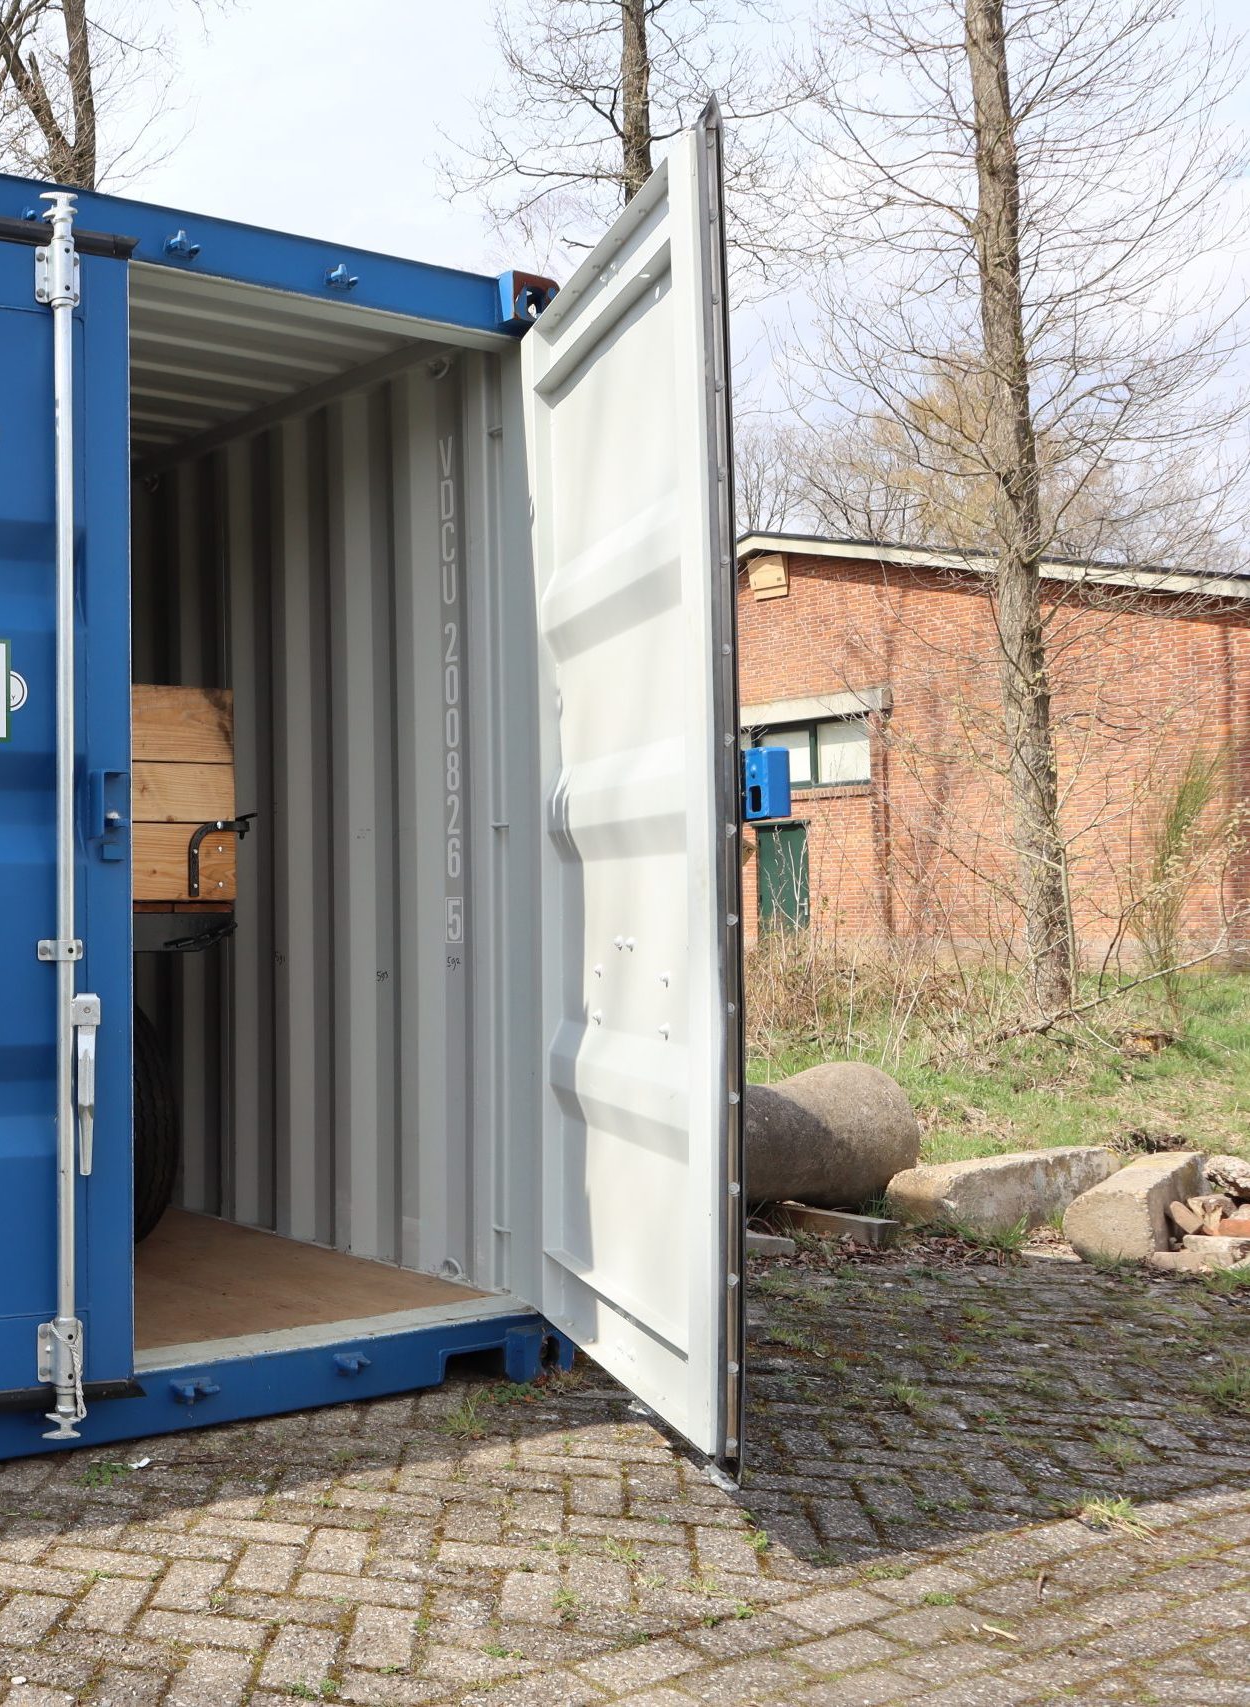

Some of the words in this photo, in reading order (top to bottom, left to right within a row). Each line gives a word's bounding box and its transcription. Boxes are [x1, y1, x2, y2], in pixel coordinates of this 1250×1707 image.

[439, 436, 456, 605] VDCU
[444, 623, 461, 879] 200826
[447, 899, 461, 940] 5
